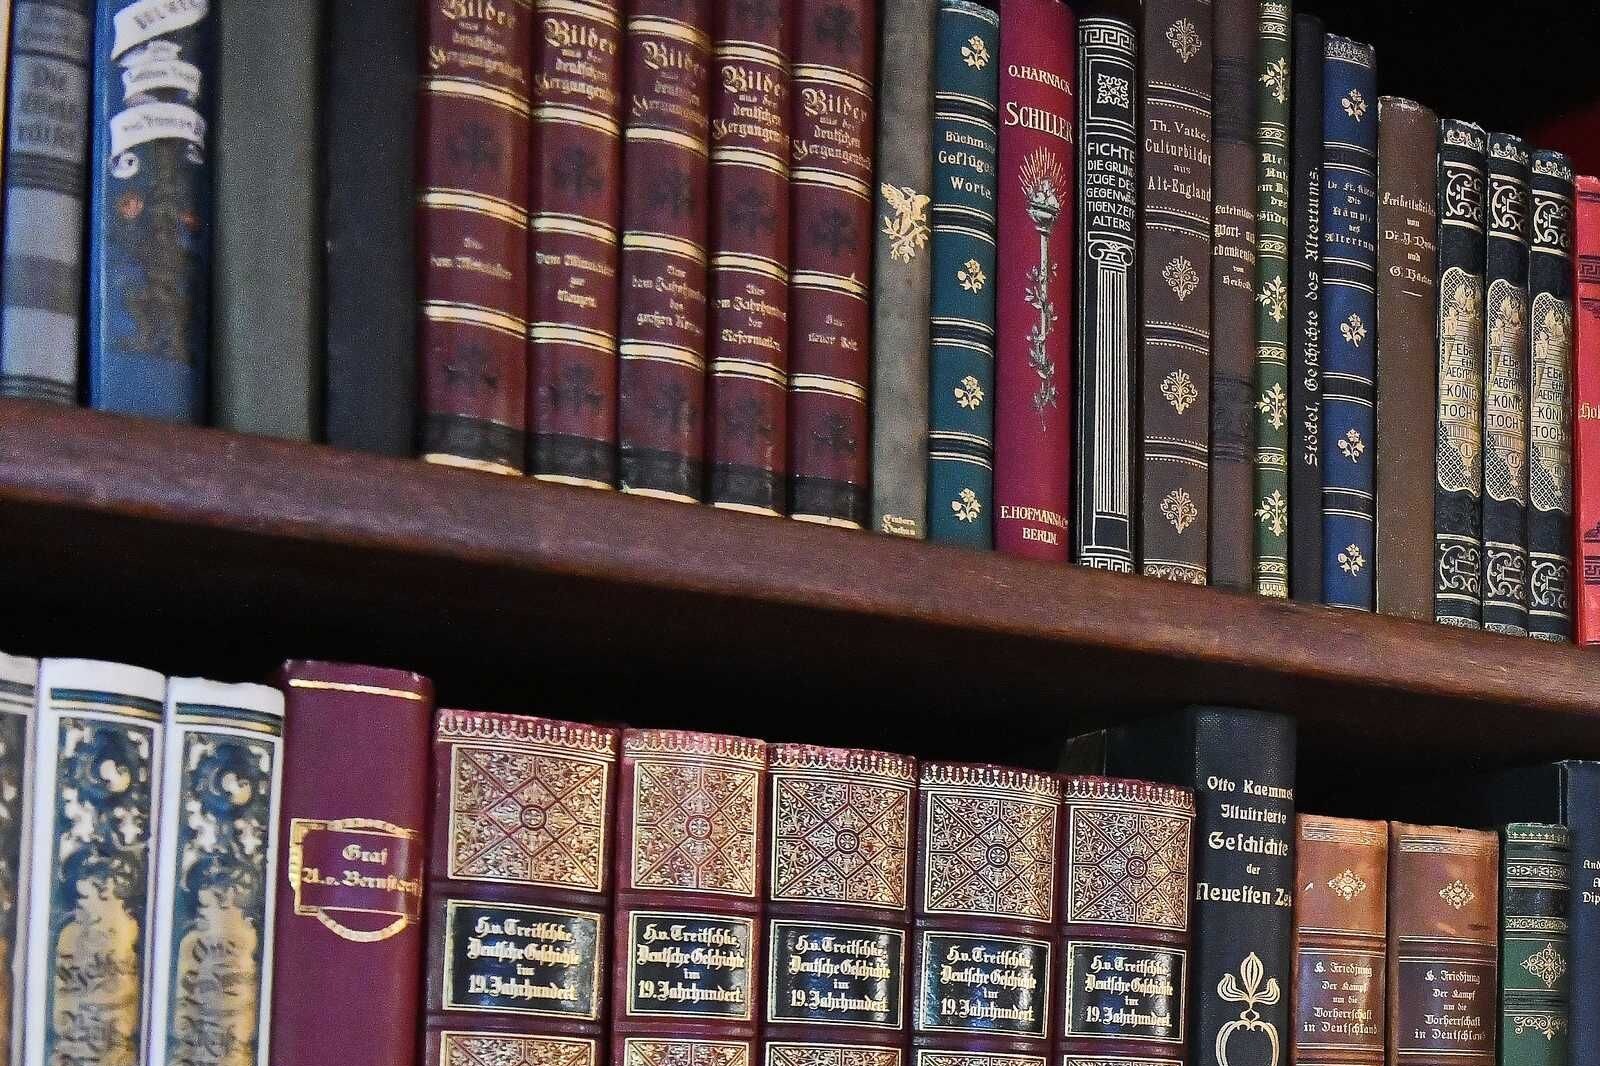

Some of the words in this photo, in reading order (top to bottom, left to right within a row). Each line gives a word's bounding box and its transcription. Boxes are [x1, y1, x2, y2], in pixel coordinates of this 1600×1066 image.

[1150, 119, 1171, 133] Th.
[1087, 142, 1136, 164] FICHTE
[1087, 160, 1104, 171] DIE
[1173, 164, 1192, 175] aus
[1147, 175, 1212, 203] Alt-England
[1092, 215, 1131, 232] ALTERS
[1304, 270, 1319, 301] des
[1206, 776, 1236, 792] Otto
[1208, 831, 1289, 857] Geschichte
[1246, 863, 1261, 875] der
[1195, 882, 1271, 905] Neuesten
[636, 944, 690, 968] Deutsche
[691, 947, 745, 970] Geschichte
[683, 968, 700, 979] im
[789, 954, 840, 977] Deutsche
[840, 959, 891, 981] Geschichte
[833, 979, 850, 989] im
[940, 964, 989, 987] Deutsche
[990, 968, 1036, 990] Geschichte
[1085, 973, 1130, 995] Deutsche
[1131, 977, 1173, 997] Geschichte
[1321, 981, 1337, 991] Der
[1341, 982, 1369, 992] Kampf
[982, 987, 999, 998] im
[1432, 988, 1448, 998] Der
[1451, 990, 1476, 1001] Kampf
[1125, 995, 1139, 1006] im
[1332, 996, 1345, 1004] um
[1443, 1003, 1455, 1011] um
[1457, 1002, 1467, 1011] die
[1423, 1014, 1481, 1028] Vorherrschaft
[1303, 1021, 1316, 1033] in
[1321, 1021, 1378, 1036] Deutschland
[1414, 1028, 1426, 1039] in
